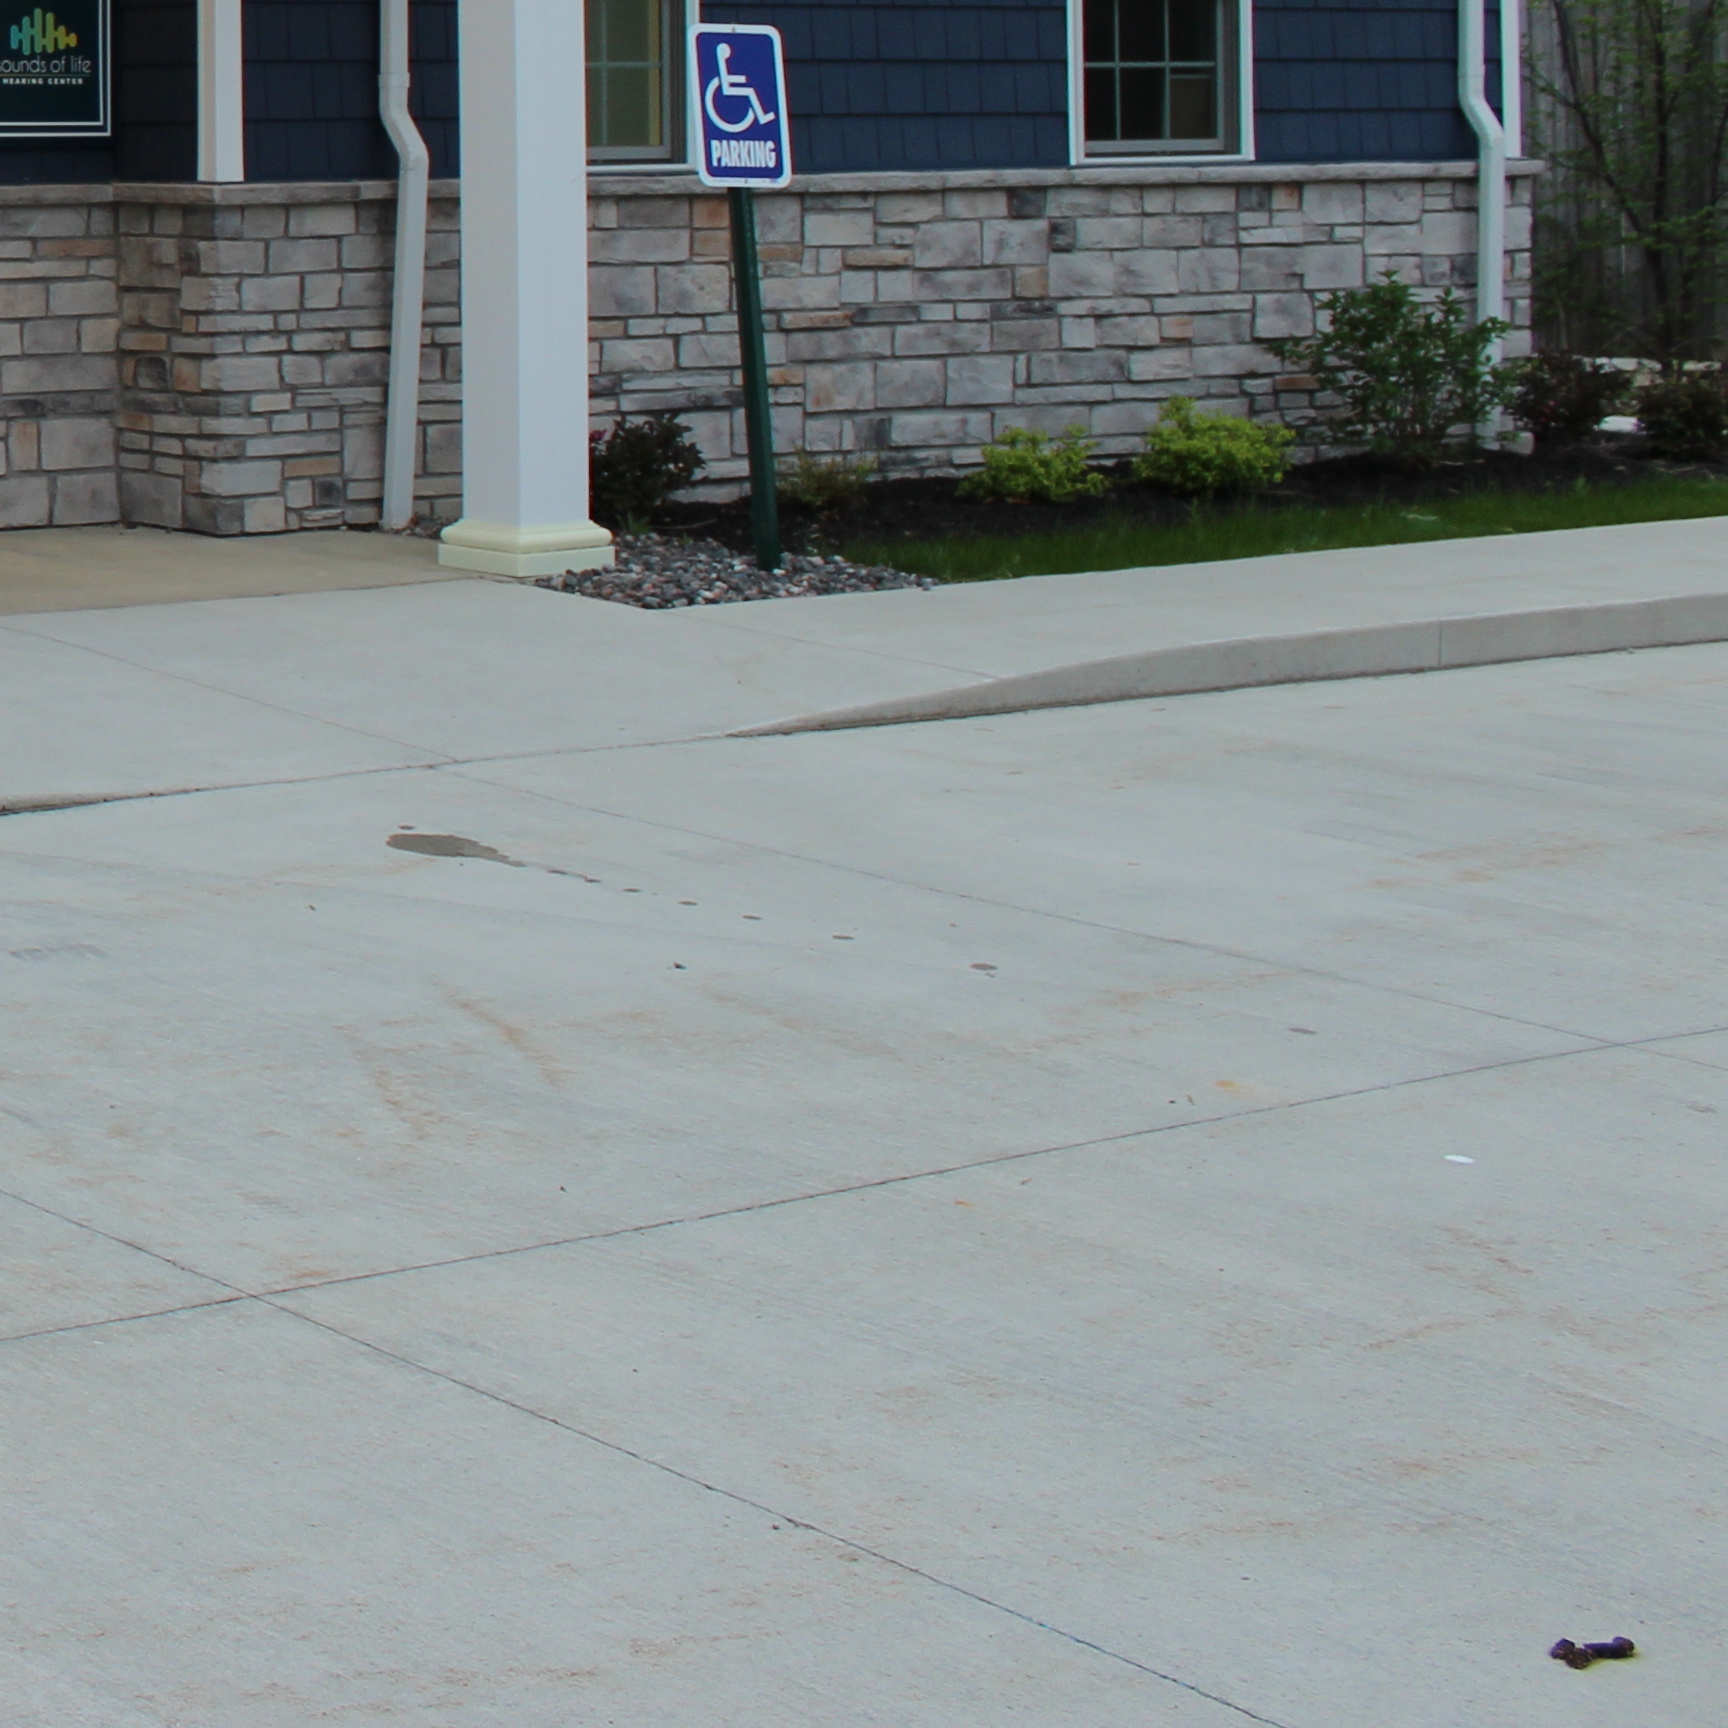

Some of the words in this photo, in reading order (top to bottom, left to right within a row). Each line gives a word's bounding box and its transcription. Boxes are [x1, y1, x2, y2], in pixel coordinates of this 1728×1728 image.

[50, 56, 67, 73] of
[70, 55, 92, 73] life
[2, 77, 44, 85] HEARING
[710, 139, 777, 169] PARKING
